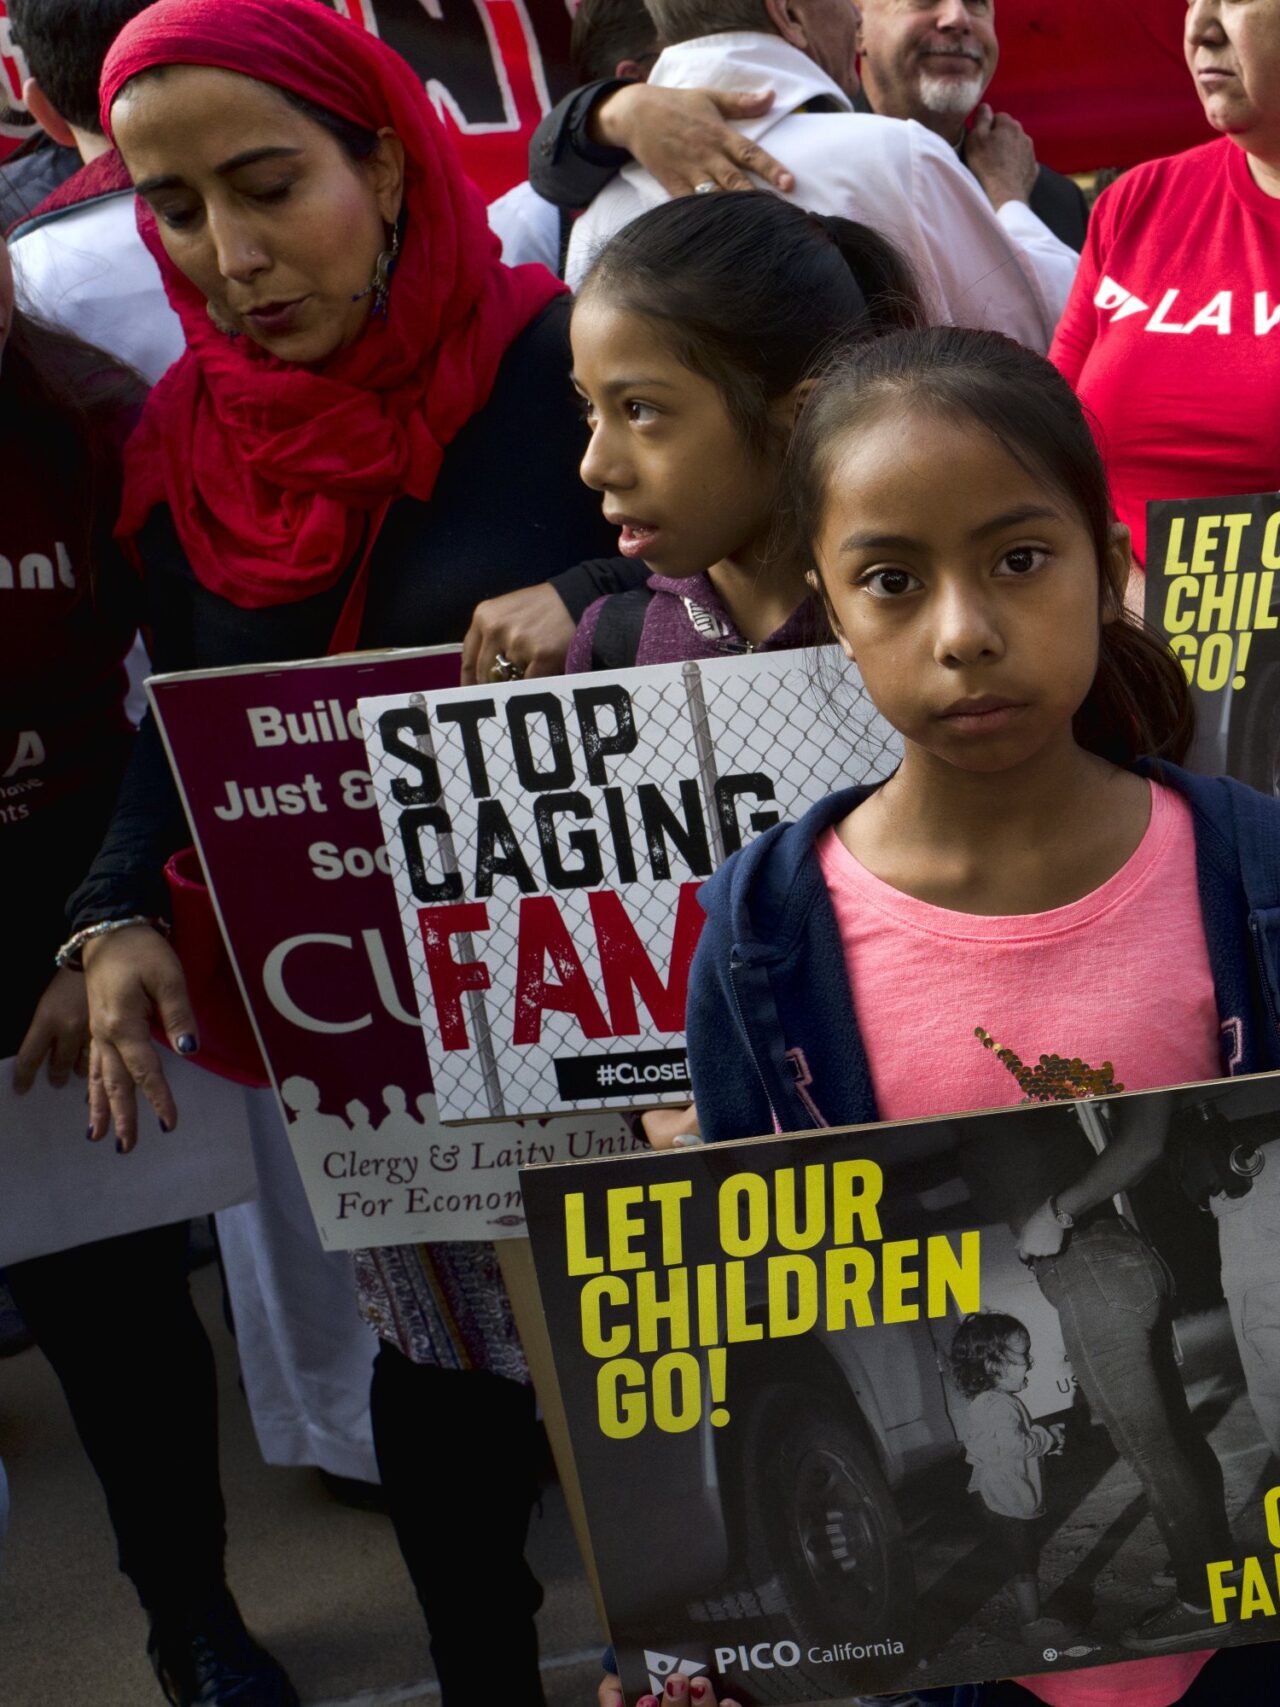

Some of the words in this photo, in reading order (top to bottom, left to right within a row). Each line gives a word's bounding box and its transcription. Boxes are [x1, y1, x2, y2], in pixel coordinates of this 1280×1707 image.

[1144, 288, 1232, 334] LA
[1164, 513, 1252, 576] LET
[379, 684, 638, 806] STOP
[214, 774, 328, 821] Just
[339, 769, 378, 810] &
[398, 772, 780, 903] CAGING
[417, 881, 709, 1052] FAM
[323, 1151, 418, 1185] Clergy
[429, 1144, 460, 1172] &
[471, 1140, 554, 1170] Laity
[336, 1191, 393, 1220] For
[565, 1180, 693, 1277] LET
[718, 1160, 883, 1258] OUR
[581, 1231, 982, 1359] CHILDREN
[597, 1347, 731, 1439] GO!
[714, 1640, 801, 1675] PICO
[807, 1638, 905, 1665] California
